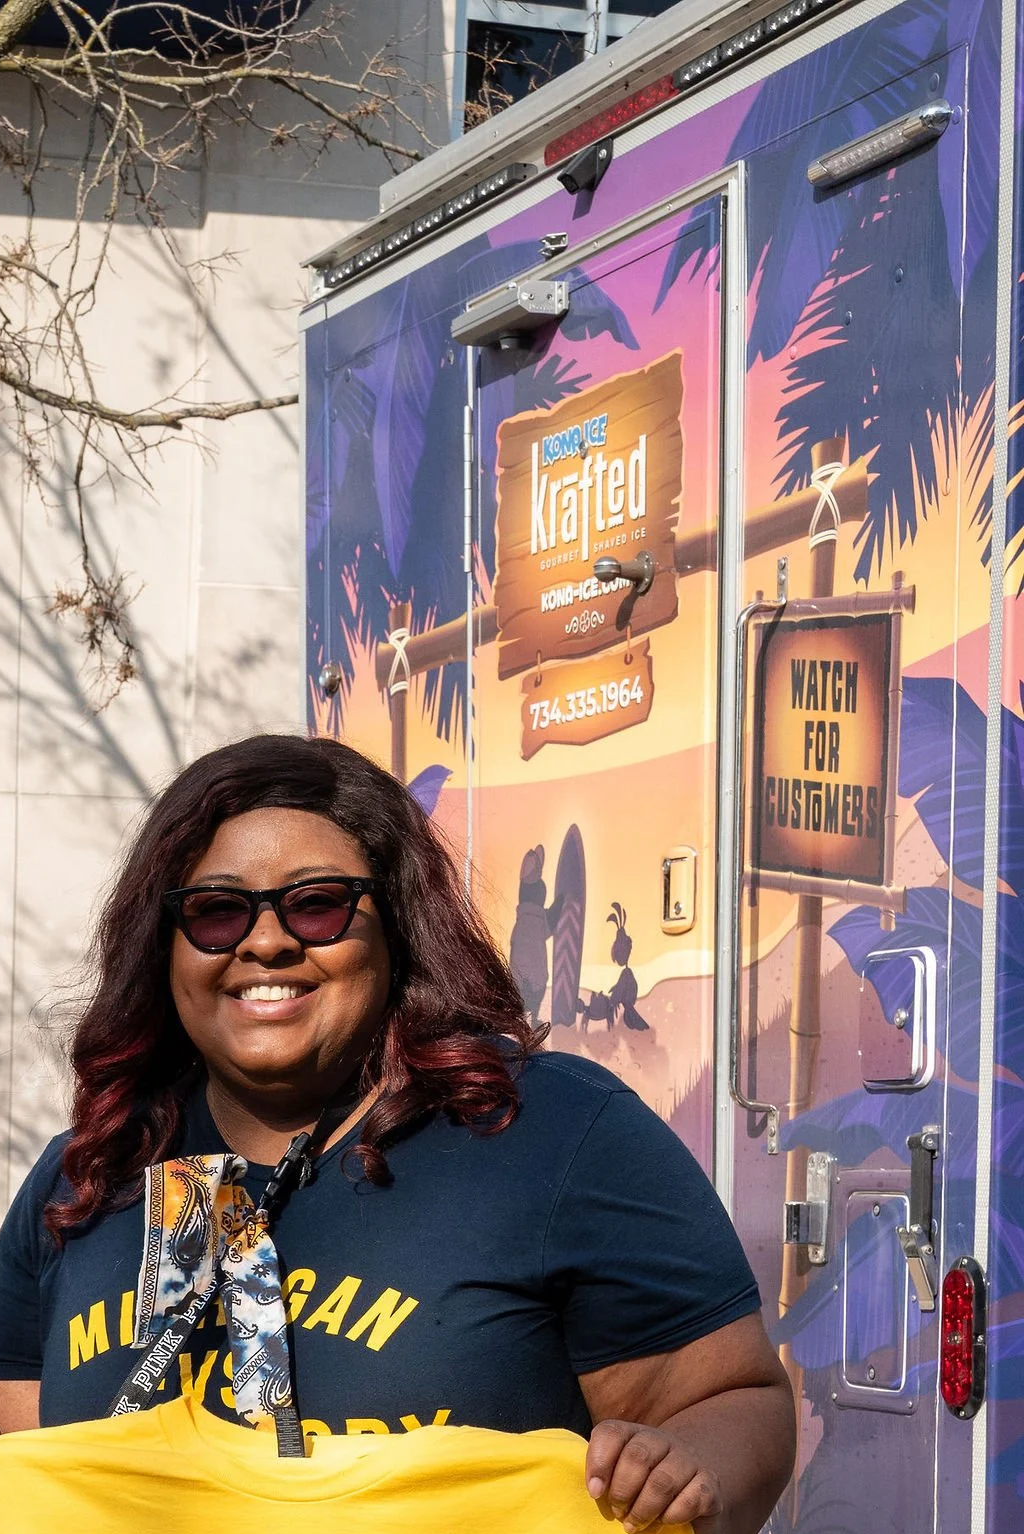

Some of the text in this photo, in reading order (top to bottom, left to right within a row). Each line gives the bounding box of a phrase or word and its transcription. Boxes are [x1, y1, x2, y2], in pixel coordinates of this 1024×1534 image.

[542, 413, 609, 466] KONA ICE
[540, 527, 647, 571] GOURMET SHAVED ICE
[529, 675, 644, 731] 734.335.1964
[791, 658, 859, 713] WATCH
[804, 720, 840, 773] FOR
[765, 776, 878, 838] CUSTOMERS
[69, 1268, 419, 1371] MIGAN
[180, 1276, 218, 1324] PIN
[132, 1329, 184, 1393] PINK
